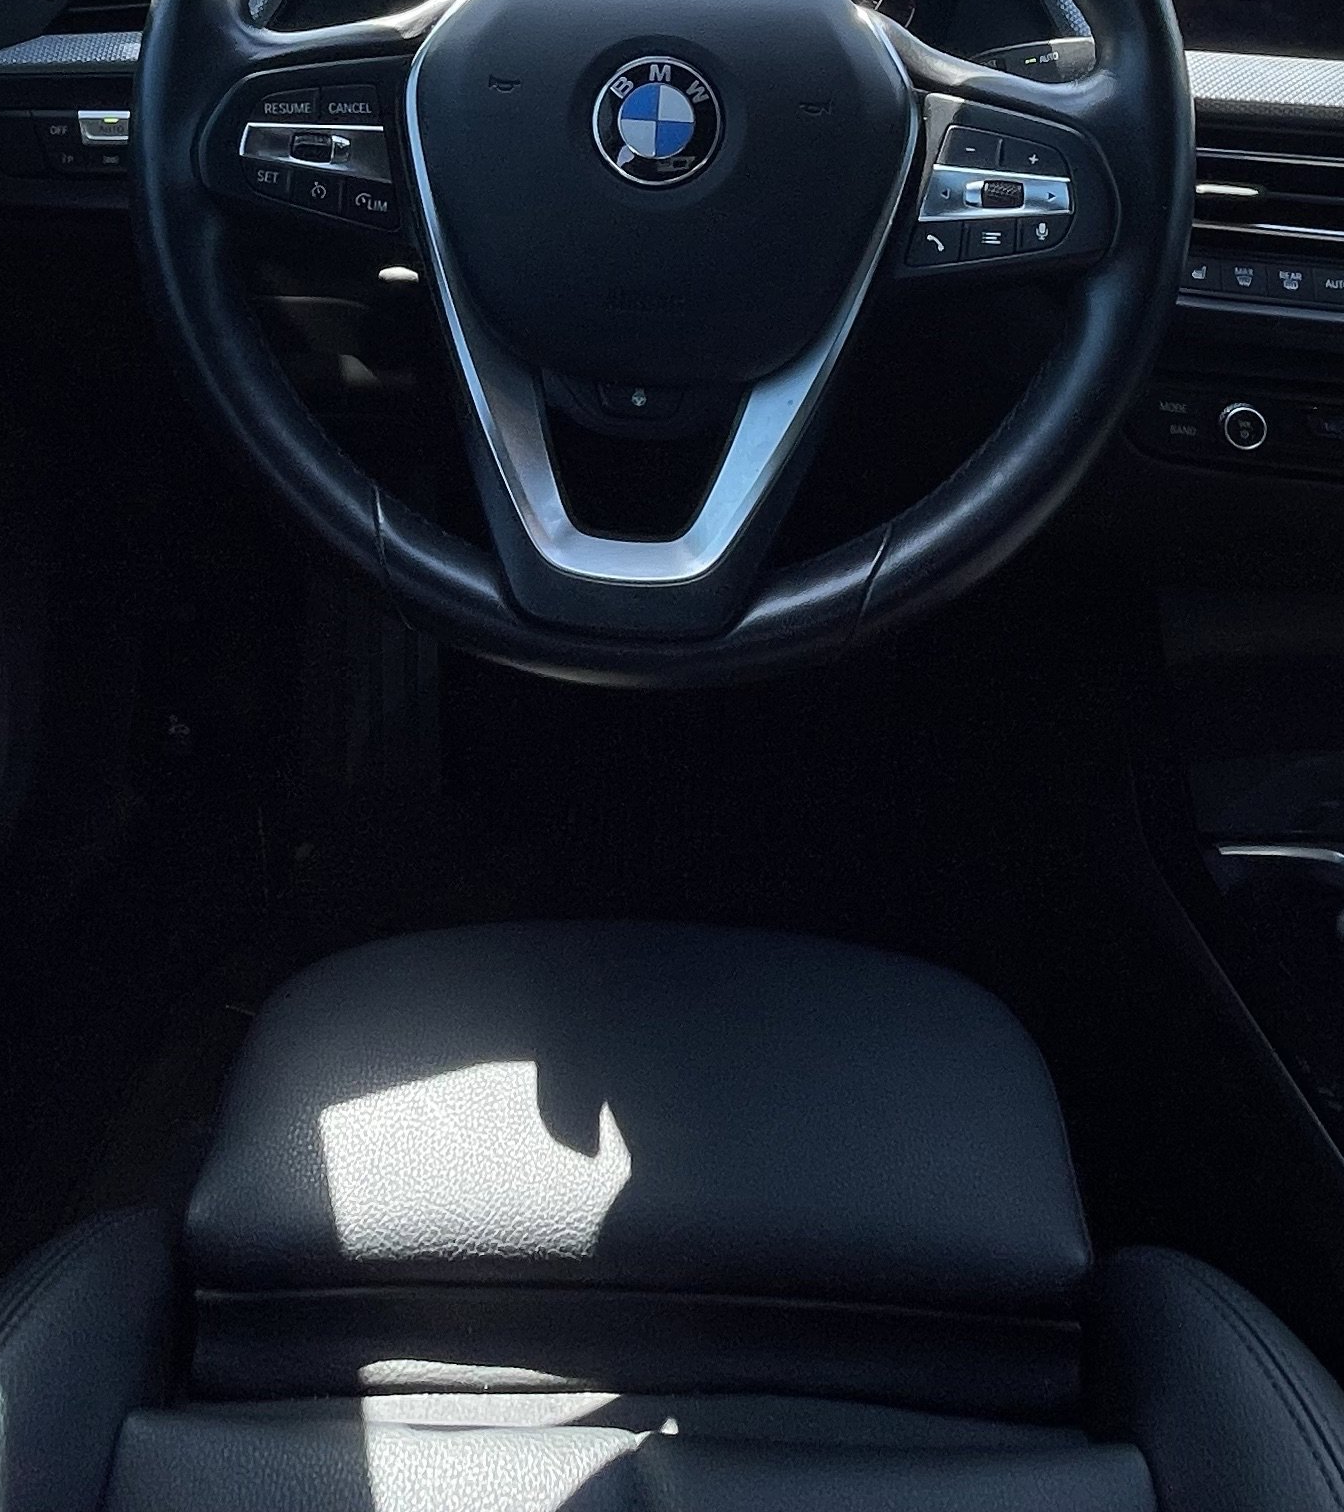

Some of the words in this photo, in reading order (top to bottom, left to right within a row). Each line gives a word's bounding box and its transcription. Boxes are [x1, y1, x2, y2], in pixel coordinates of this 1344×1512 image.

[1039, 51, 1059, 64] AUTO
[610, 64, 709, 104] BMW
[264, 102, 313, 115] RESUME
[328, 102, 373, 115] CANCEL
[257, 170, 281, 184] SET
[366, 198, 388, 212] LIM
